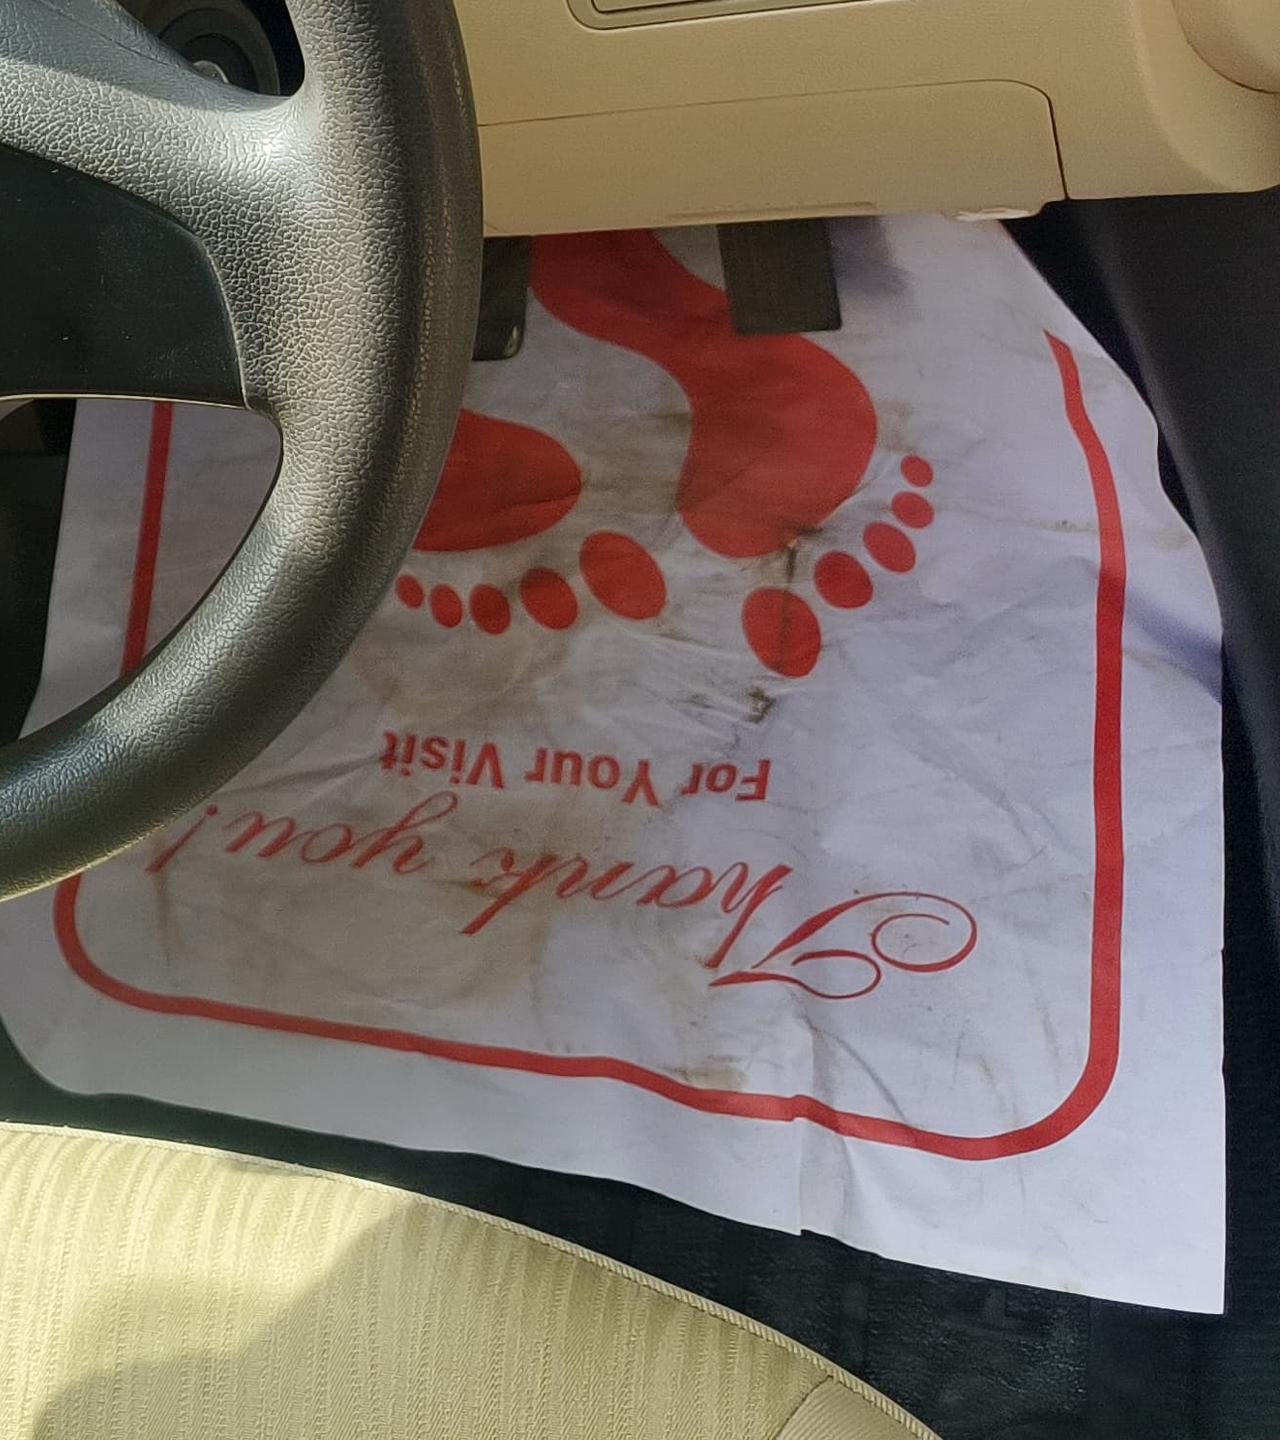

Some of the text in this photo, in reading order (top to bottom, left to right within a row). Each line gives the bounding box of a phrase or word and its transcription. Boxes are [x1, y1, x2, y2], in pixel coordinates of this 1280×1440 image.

[379, 730, 771, 807] For Your Visit
[461, 843, 978, 1000] Thank
